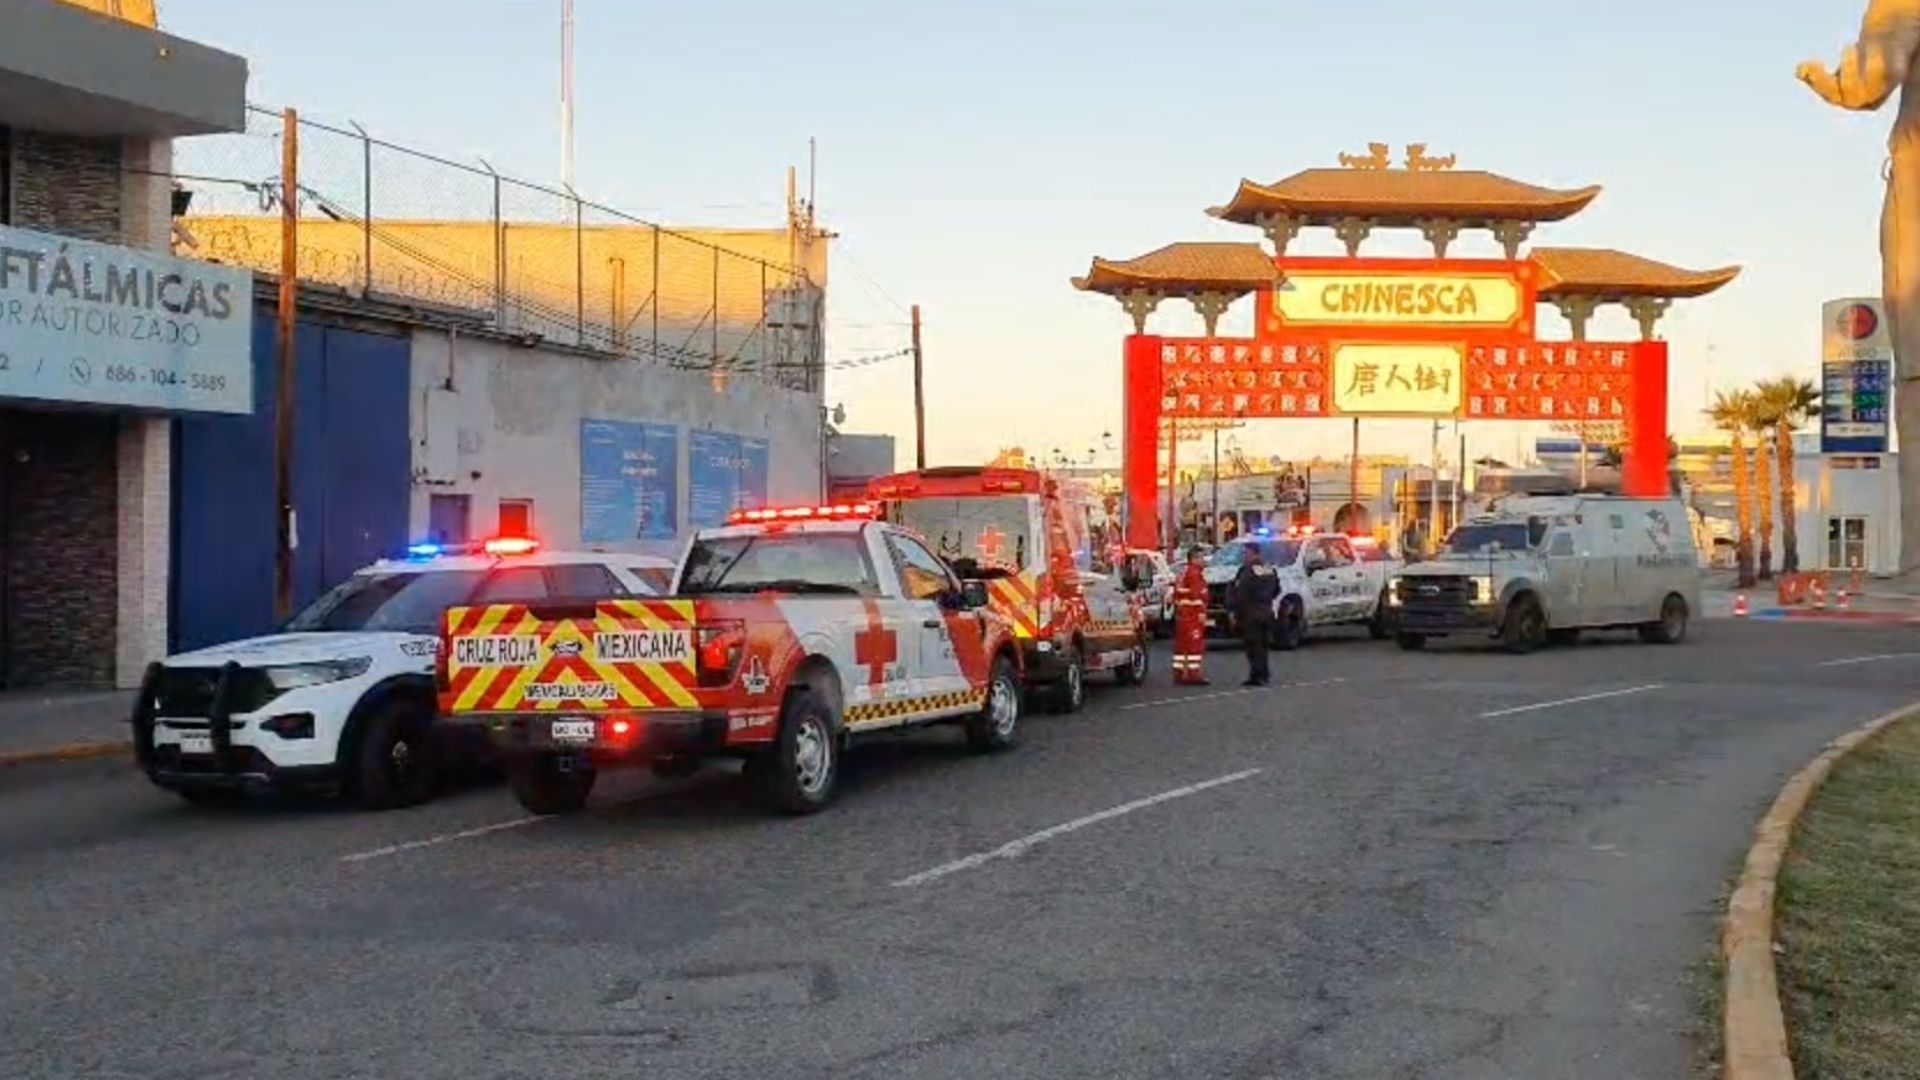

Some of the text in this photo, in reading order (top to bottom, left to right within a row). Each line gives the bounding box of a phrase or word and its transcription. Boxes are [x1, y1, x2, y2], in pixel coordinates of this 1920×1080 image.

[0, 242, 231, 319] FTÁLMICAS
[1321, 283, 1476, 315] CHINESCA
[0, 299, 201, 348] R AUTORIZADO
[457, 638, 494, 663] CRUZ
[499, 637, 537, 663] ROJA
[597, 632, 687, 659] MEXICANA
